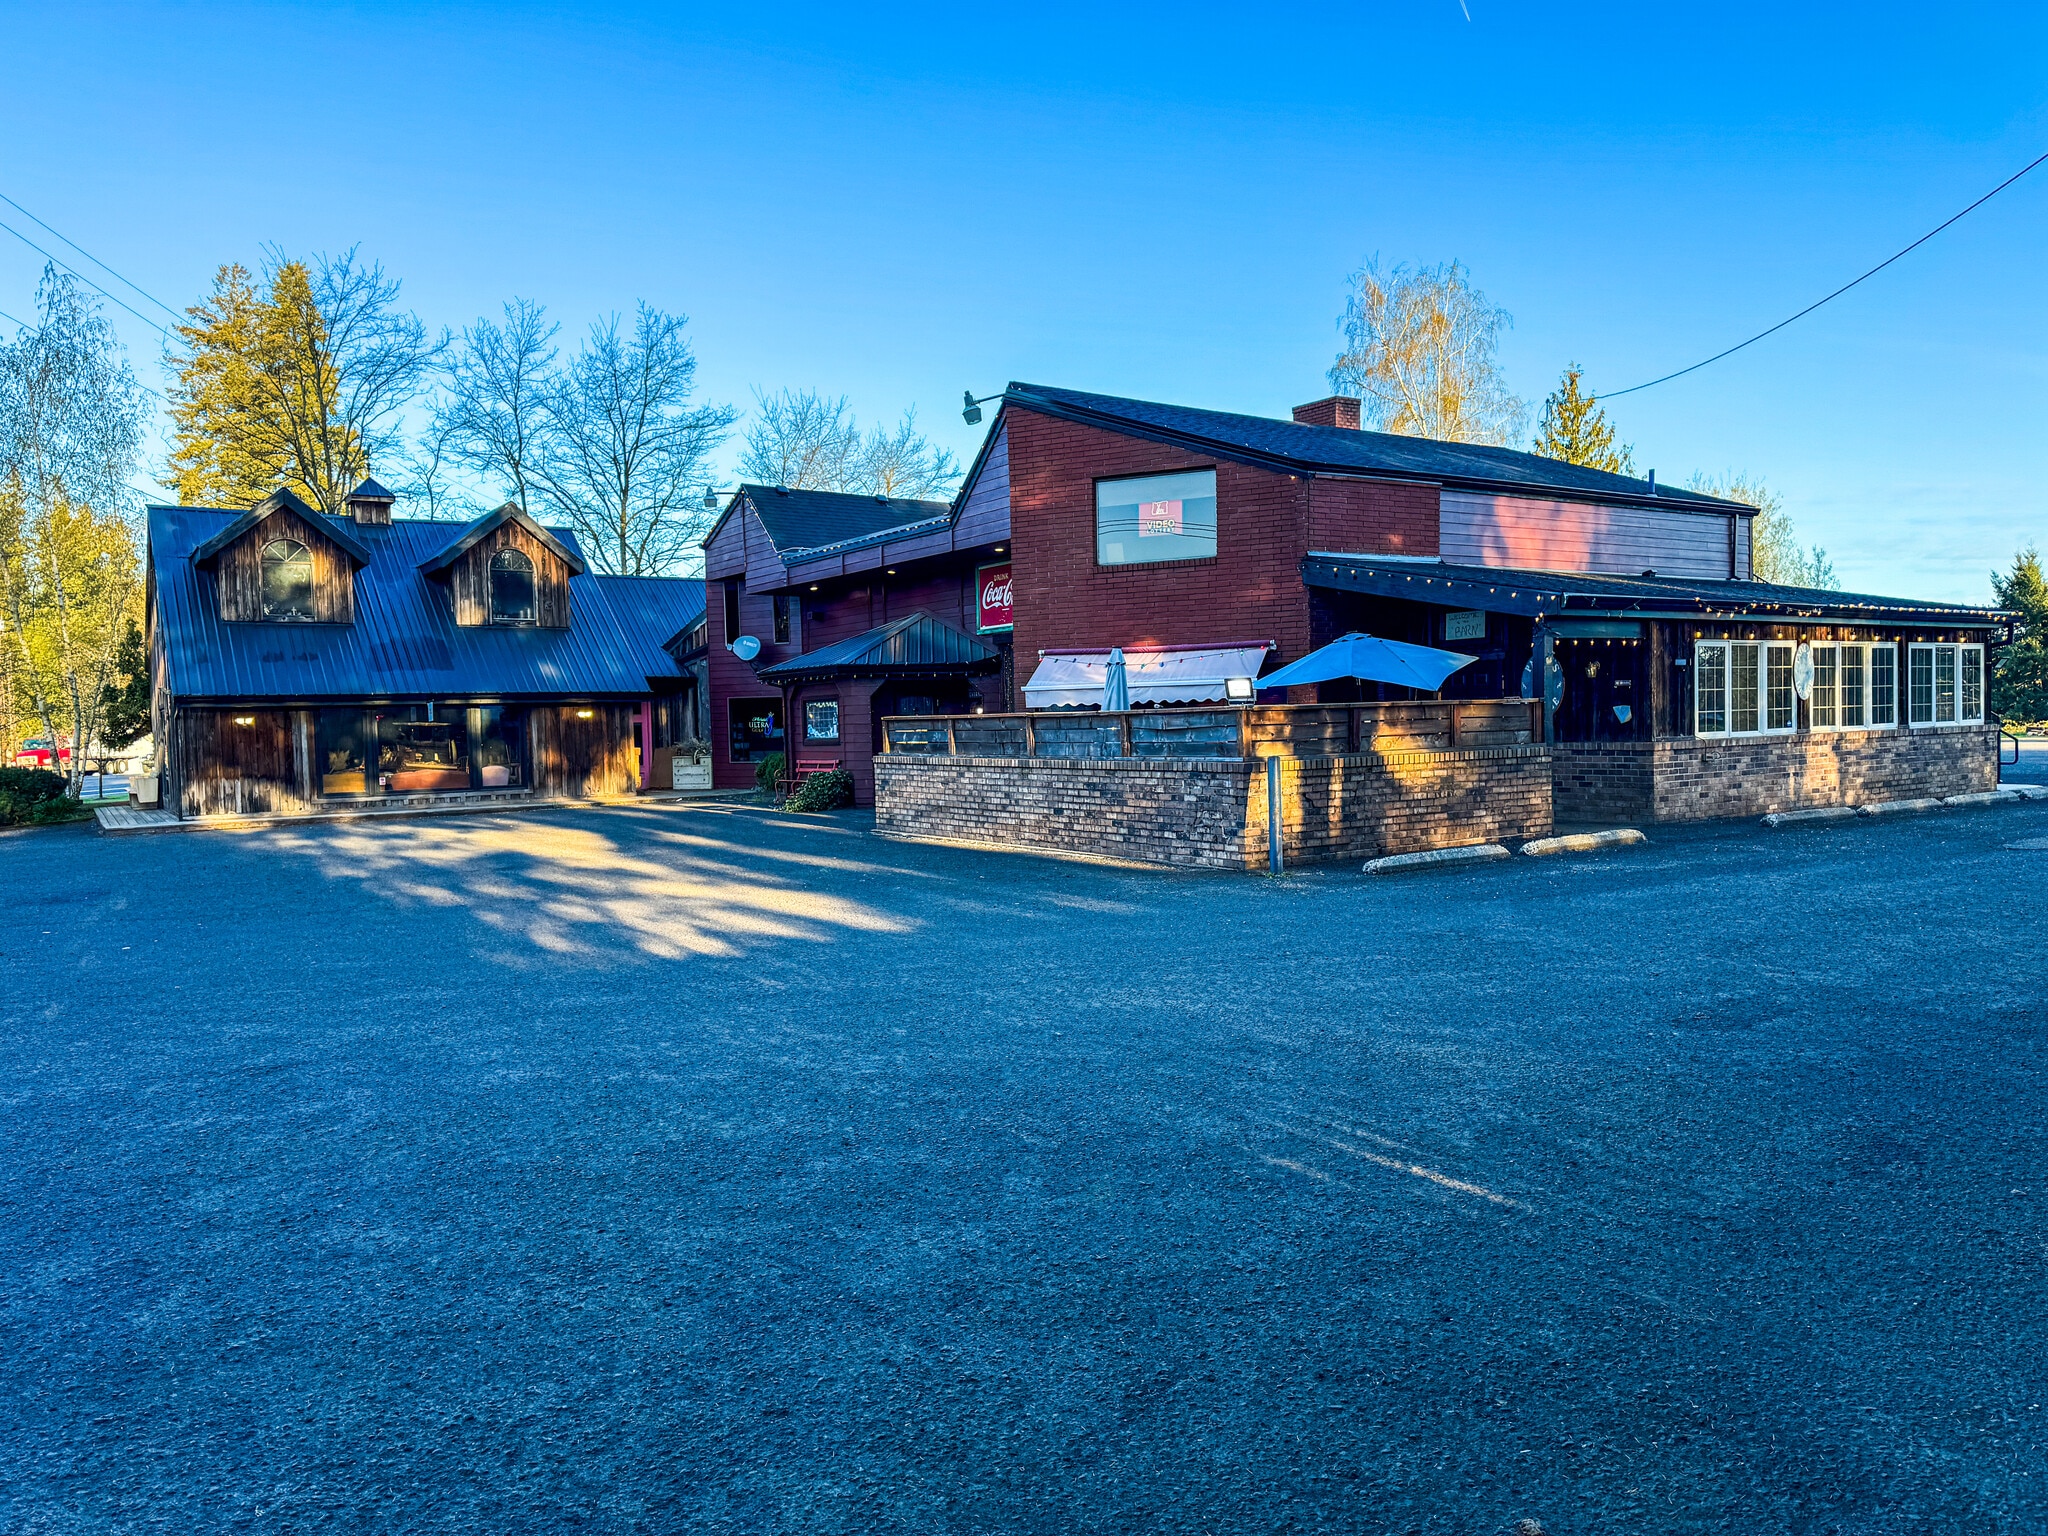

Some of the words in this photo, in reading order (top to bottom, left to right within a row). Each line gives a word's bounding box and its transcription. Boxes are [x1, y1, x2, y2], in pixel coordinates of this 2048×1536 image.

[1146, 519, 1175, 529] VIDEO
[993, 573, 1009, 582] DRINK
[748, 721, 770, 729] ULTRA
